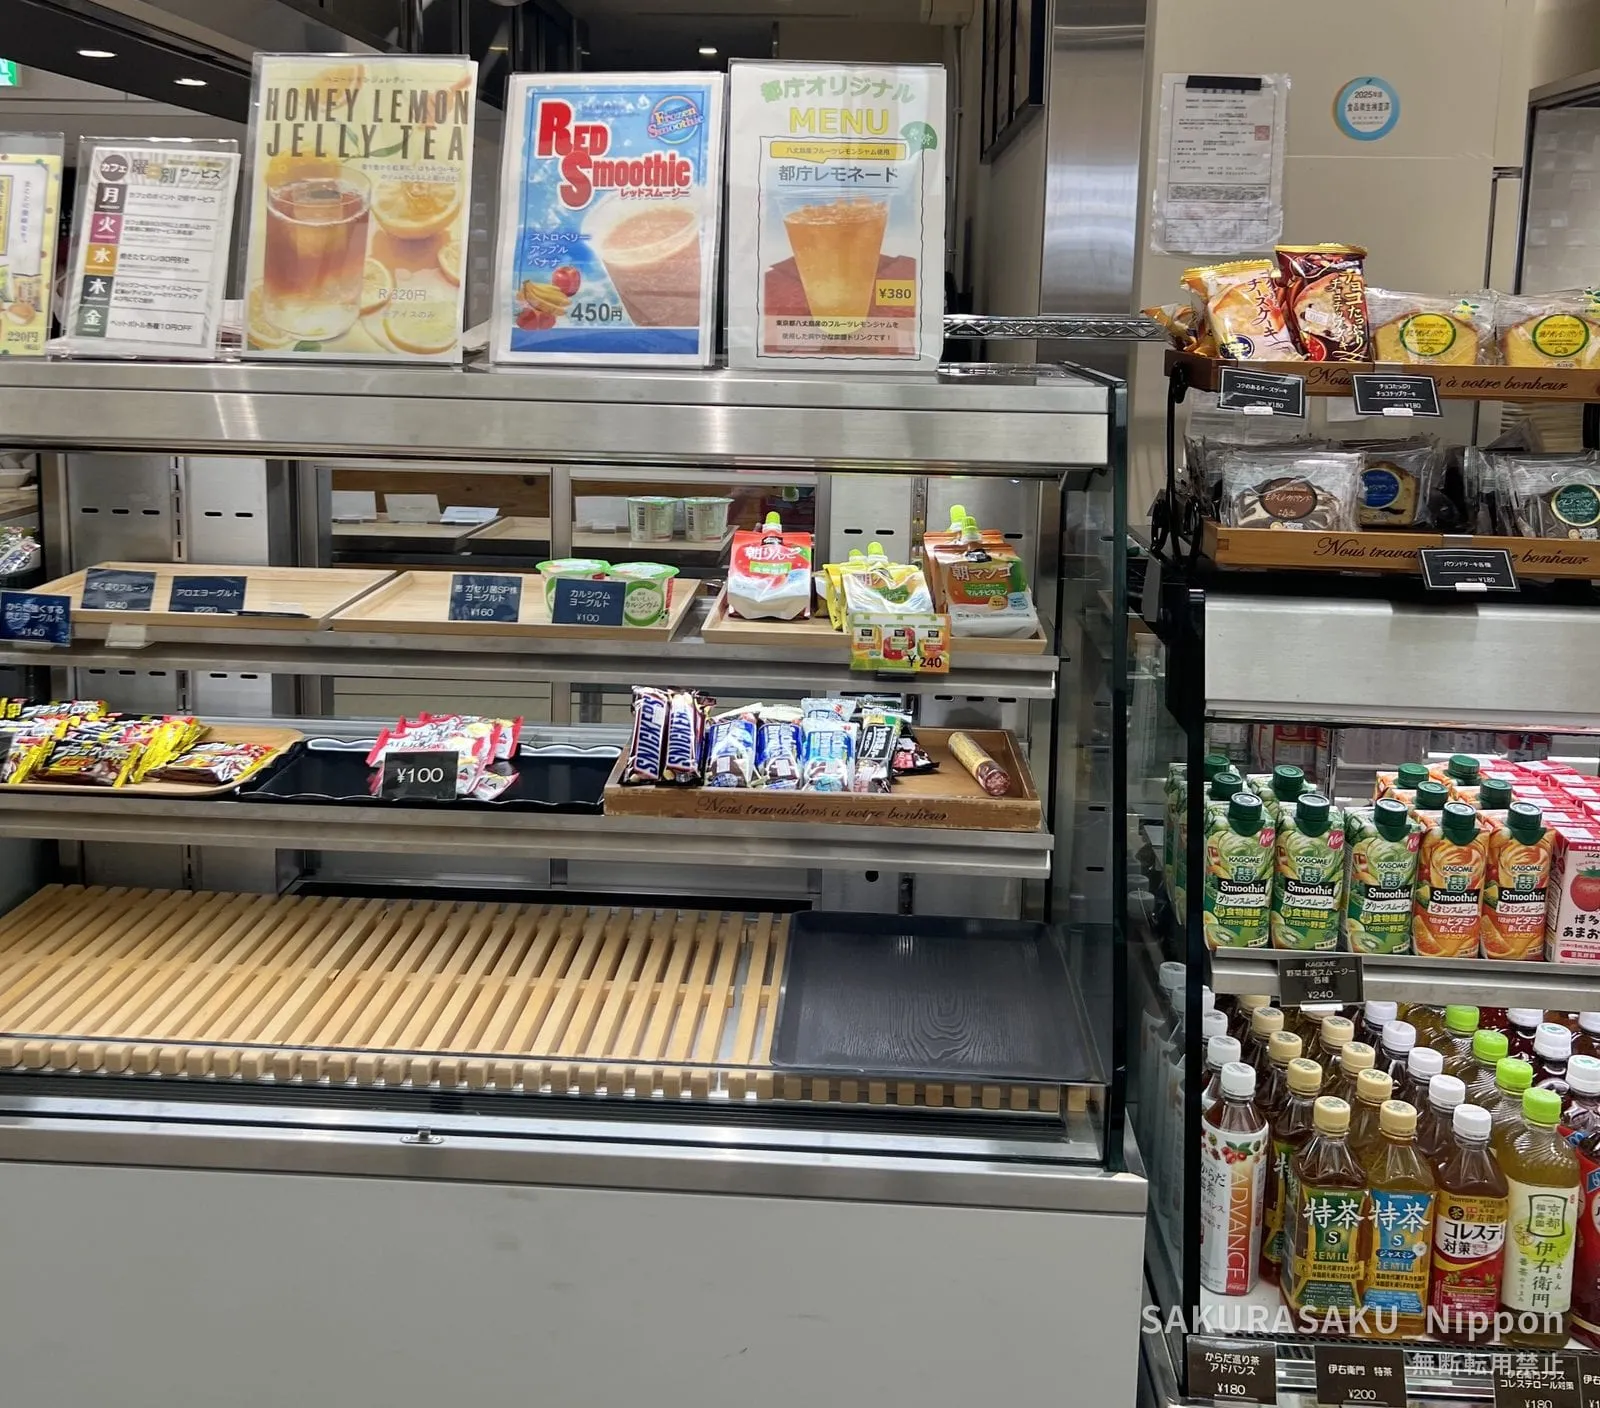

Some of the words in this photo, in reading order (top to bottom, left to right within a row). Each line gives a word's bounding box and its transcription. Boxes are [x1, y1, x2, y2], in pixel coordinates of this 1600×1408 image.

[761, 77, 916, 103] 都庁オリジナル
[265, 87, 359, 124] HONEY
[373, 89, 470, 125] LEMON
[789, 106, 890, 136] MENU
[538, 101, 609, 157] RED
[266, 123, 378, 159] JELLY
[400, 125, 465, 161] TEA
[101, 162, 128, 173] カフェ
[180, 167, 221, 180] サービス
[560, 151, 691, 208] Smoothie
[778, 165, 899, 184] 都庁レモネード
[103, 187, 120, 203] 月
[620, 188, 690, 198] レッドスムージー
[98, 216, 116, 233] 火
[531, 232, 591, 243] ストロベリー
[94, 247, 112, 263] 水
[530, 244, 569, 255] アップル
[528, 257, 561, 267] バナナ
[89, 278, 107, 294] 木
[377, 288, 388, 299] R
[879, 288, 912, 299] ¥380
[571, 303, 623, 322] 450円
[1247, 277, 1279, 342] チーズケーキ
[84, 309, 102, 325] 金
[1446, 376, 1459, 388] à
[1461, 379, 1500, 390] votre
[1504, 376, 1569, 392] bonheur
[1313, 537, 1365, 558] Nous
[1521, 549, 1590, 566] bonheur
[176, 588, 241, 598] アロエヨーグルト
[465, 584, 518, 595] ガセリ菌SP株
[570, 590, 611, 599] カルシウム
[465, 593, 506, 602] ヨーグルト
[570, 598, 611, 608] ヨーグルト
[104, 601, 127, 610] ¥240
[470, 608, 494, 617] ¥160
[576, 613, 600, 623] ¥100
[920, 656, 943, 668] 240
[397, 766, 444, 783] ¥100
[695, 795, 742, 815] Nous
[888, 806, 950, 822] bonheur
[1228, 856, 1261, 864] KAGOME
[1296, 856, 1327, 865] KAGOME
[1442, 865, 1474, 873] KAGOME
[1511, 864, 1542, 872] KAGOME
[1220, 881, 1265, 894] Smoothie
[1287, 881, 1333, 895] Smoothie
[1367, 888, 1410, 899] Smoothie
[1217, 895, 1265, 905] グリーンスムージー
[1284, 896, 1333, 906] グリーンスムージー
[1433, 890, 1478, 902] Smoothie
[1501, 890, 1545, 902] Smoothie
[1364, 901, 1410, 911] グリーンスムージー
[1430, 904, 1477, 914] ビタミンスムージー
[1498, 903, 1544, 914] ビタミンスムージー
[1574, 914, 1600, 926] 博多
[1305, 960, 1337, 968] KAGOME
[1286, 968, 1357, 977] 野菜生活スムージー
[1314, 976, 1330, 984] 各種
[1307, 990, 1334, 999] ¥240
[1302, 1197, 1365, 1231] 特茶
[1368, 1199, 1430, 1234] 特茶
[1546, 1204, 1561, 1230] 京都
[1227, 1169, 1249, 1280] ADVANCE
[1444, 1220, 1500, 1241] コレステ
[1327, 1231, 1339, 1244] S
[1392, 1235, 1403, 1247] S
[1443, 1239, 1471, 1255] 対策
[1379, 1250, 1416, 1259] ジャスミン
[1531, 1241, 1557, 1309] 伊右衛門
[1205, 1351, 1261, 1366] からだ巡り茶
[1210, 1363, 1257, 1376] アドバンス
[1328, 1364, 1366, 1376] 伊右衛門
[1374, 1366, 1393, 1377] 特茶
[1216, 1383, 1246, 1395] ¥180
[1500, 1379, 1575, 1391] コレステロール対策
[1348, 1389, 1377, 1401] ¥200
